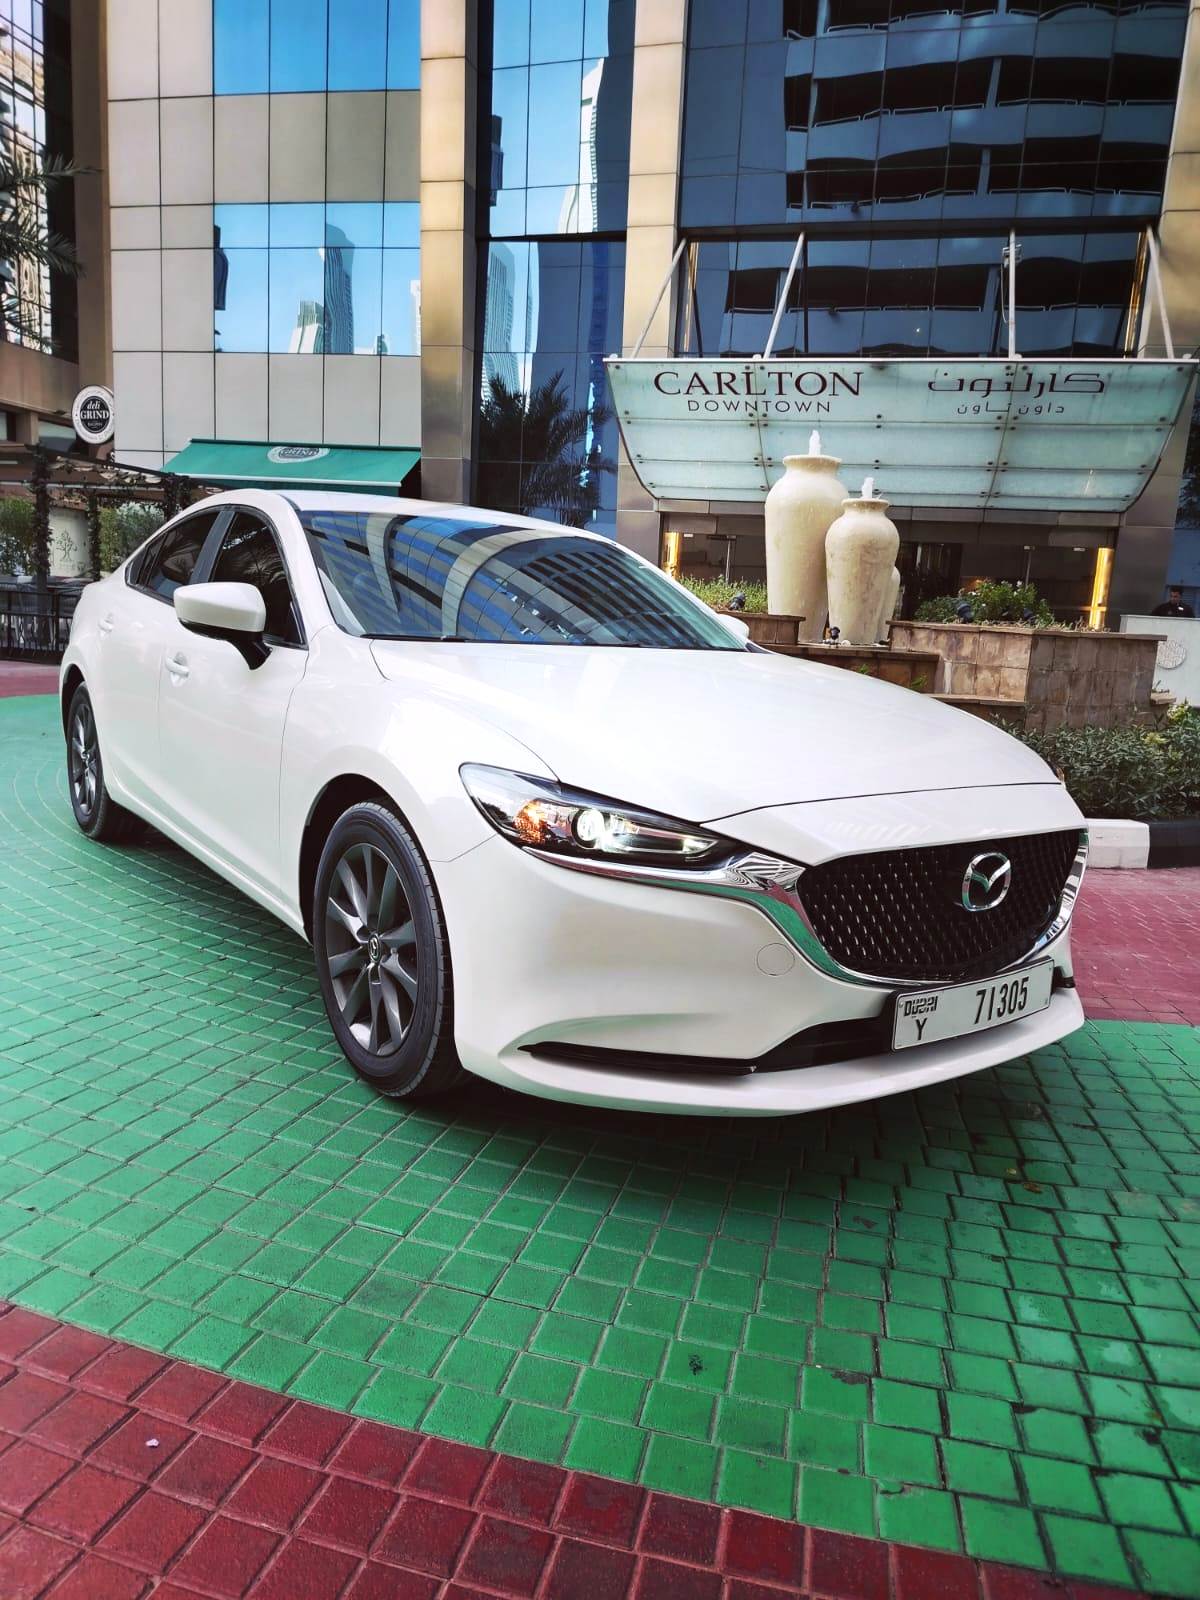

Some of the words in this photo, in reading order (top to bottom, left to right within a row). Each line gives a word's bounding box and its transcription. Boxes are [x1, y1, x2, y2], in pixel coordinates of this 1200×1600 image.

[654, 371, 863, 396] CARLTON
[927, 372, 1105, 398] كارلتون
[87, 401, 100, 409] deli
[688, 400, 830, 412] DOWNTOWN
[957, 401, 1012, 415] تاون
[1018, 402, 1065, 415] داون
[80, 410, 109, 420] GRIND
[975, 977, 1029, 1024] 71305
[915, 1017, 928, 1041] Y
